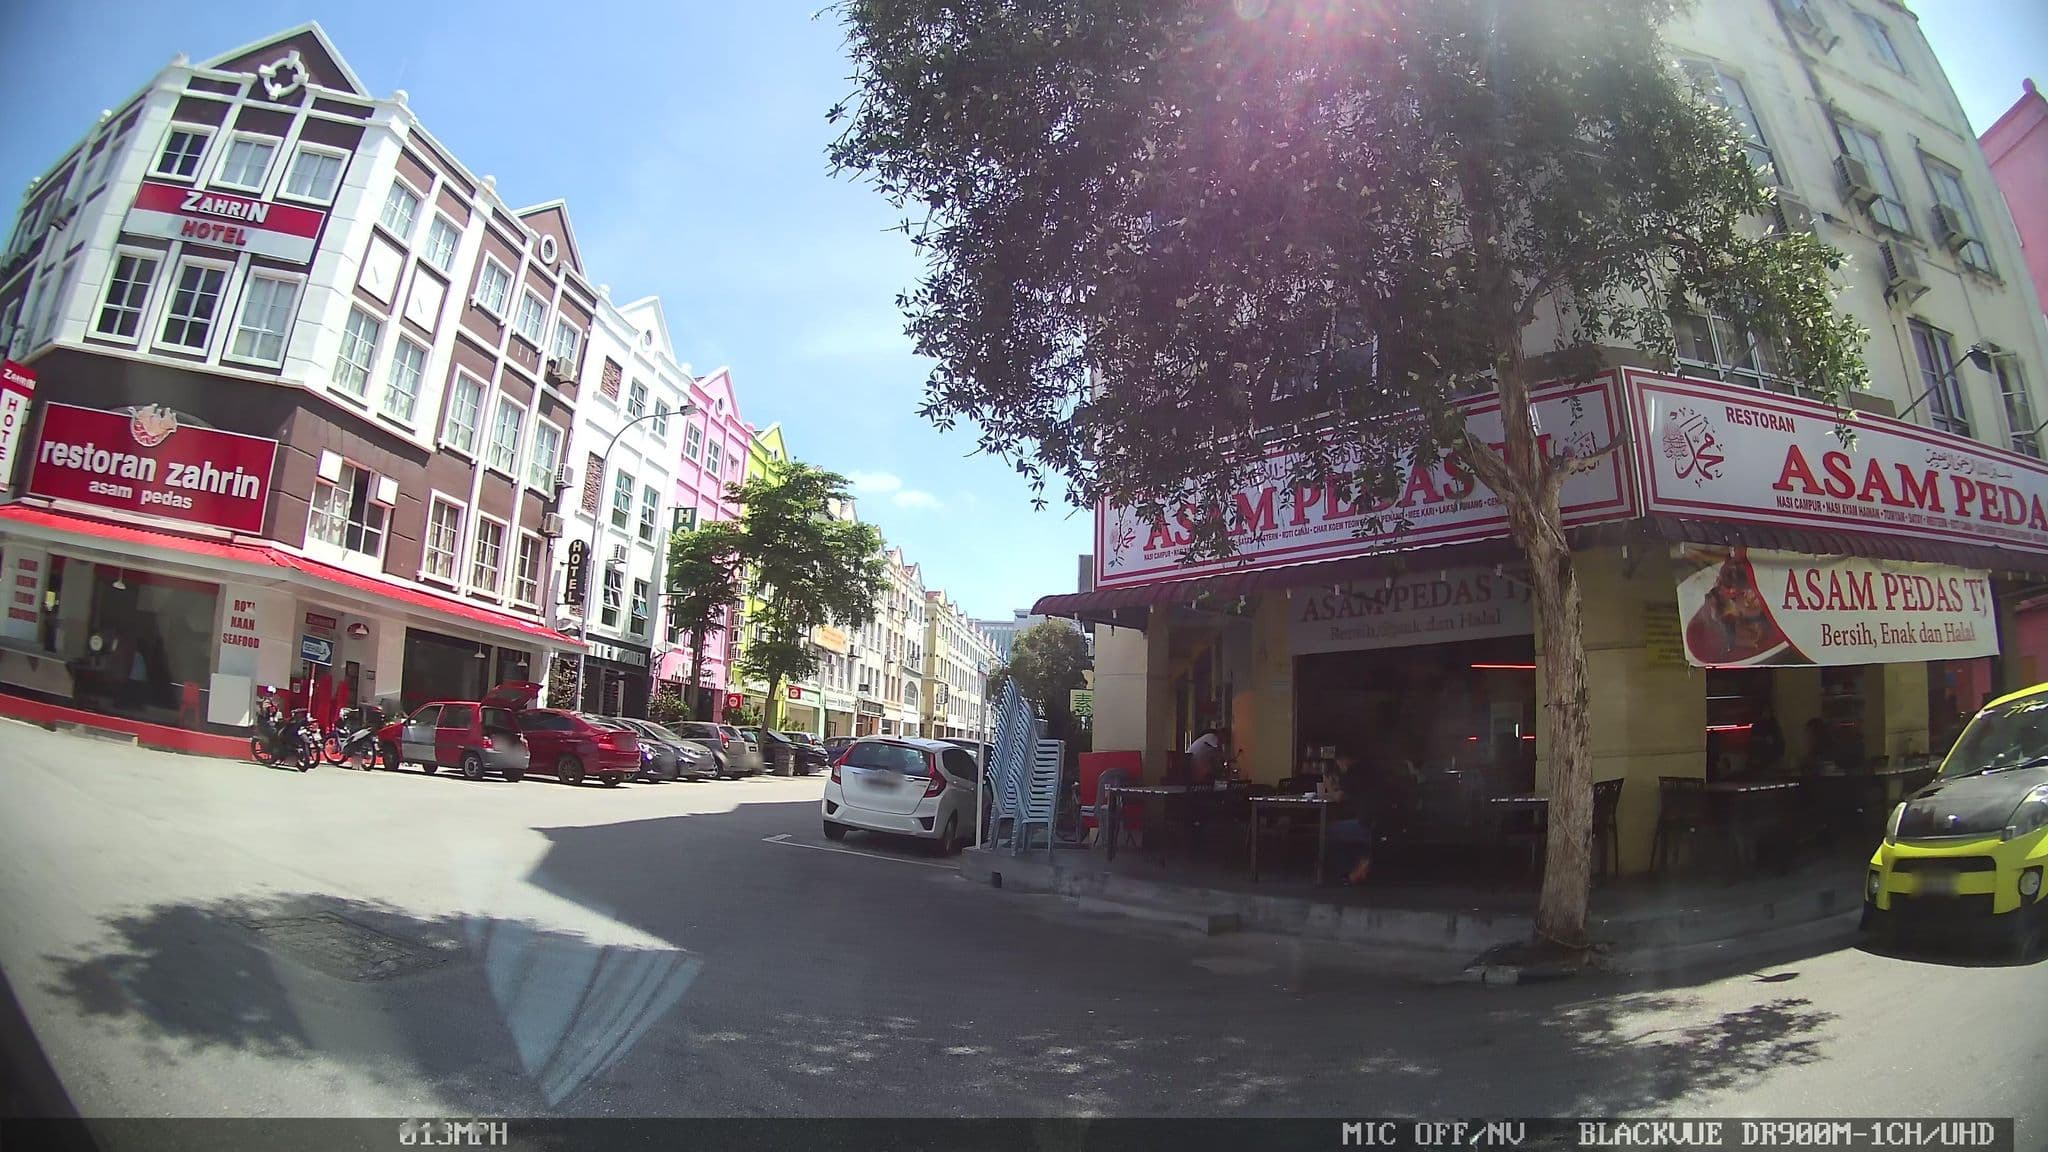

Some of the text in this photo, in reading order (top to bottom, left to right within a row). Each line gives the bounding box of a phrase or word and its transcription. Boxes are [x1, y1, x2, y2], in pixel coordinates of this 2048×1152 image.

[181, 191, 270, 224] ZAHRIN
[181, 220, 247, 246] HOTEL
[1726, 406, 1795, 434] RESTORAN
[0, 398, 18, 479] HOTE
[40, 440, 260, 500] restoran zahrin
[1772, 444, 1945, 514] ASAM
[89, 480, 193, 510] asam pedas
[1776, 495, 1794, 509] NASI
[1795, 497, 1823, 513] CAMPUR
[567, 541, 583, 602] HOTEL
[1300, 592, 1386, 623] ASAM
[1391, 575, 1493, 613] PEDAS
[1781, 568, 1878, 611] ASAM
[1881, 572, 1963, 613] PEDAS
[222, 632, 260, 649] SEAFOOD
[1820, 620, 1977, 649] Bersih, Enak dan Halal
